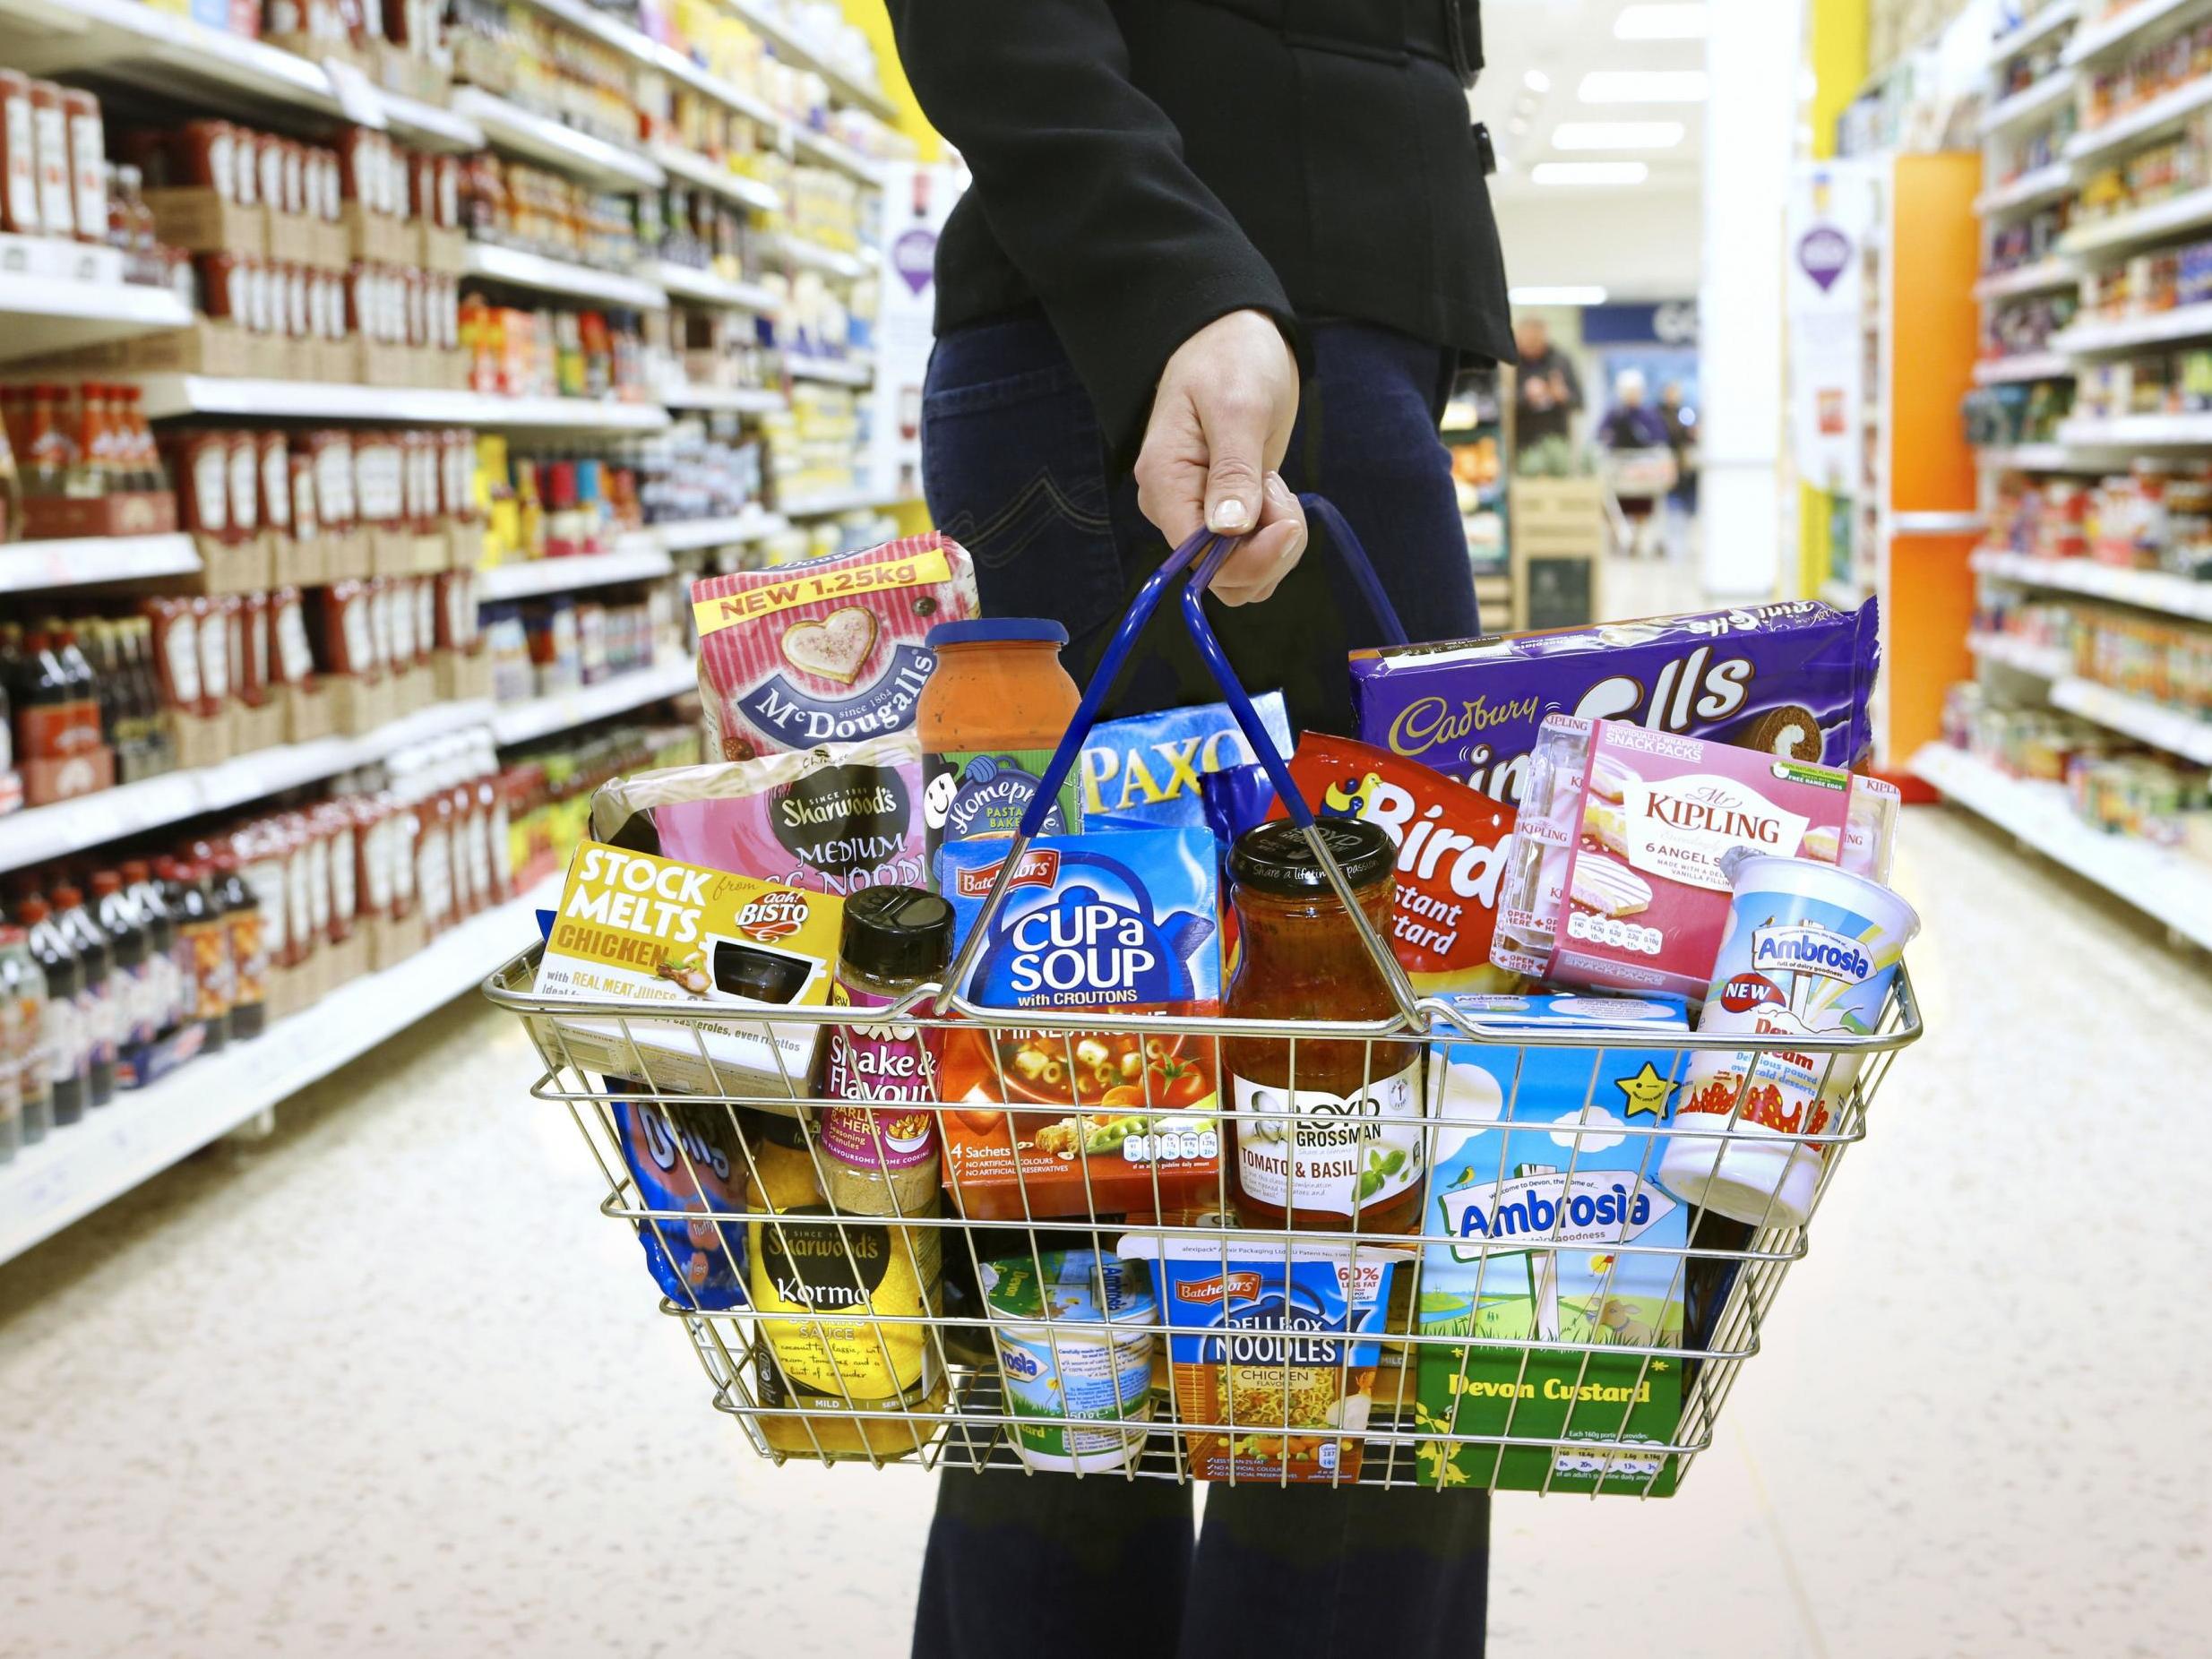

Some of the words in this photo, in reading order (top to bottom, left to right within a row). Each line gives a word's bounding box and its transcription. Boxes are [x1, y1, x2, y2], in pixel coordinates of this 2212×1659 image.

[720, 582, 799, 620] NEW
[811, 564, 917, 596] 1.25kg
[756, 656, 933, 739] McDougalls
[839, 703, 867, 718] since
[870, 689, 891, 708] 1864
[1389, 696, 1539, 757] Cadbury
[1605, 733, 1655, 750] SNACK
[1656, 742, 1702, 761] PACKS
[1805, 778, 1827, 787] RANGE
[782, 786, 897, 828] Sharwood's
[810, 792, 839, 804] SINCE
[1644, 791, 1780, 844] KIPLING
[1521, 822, 1568, 842] KIPLING
[796, 833, 907, 867] MEDIUM
[1646, 843, 1655, 852] 6
[1657, 845, 1709, 865] ANGEL
[580, 848, 714, 907] STOCK
[1253, 864, 1279, 879] Share
[1347, 859, 1379, 879] passion
[1672, 869, 1702, 881] VANILLA
[764, 890, 805, 906] aah!
[1395, 882, 1462, 926] stant
[565, 883, 701, 942] MELTS
[736, 903, 809, 927] BISTO
[1507, 910, 1533, 921] OPEN
[556, 924, 670, 967] CHICKEN
[1759, 935, 1869, 979] Ambrosia
[1011, 948, 1155, 993] SOUP
[1510, 955, 1534, 965] OPEN
[547, 970, 569, 984] with
[572, 971, 600, 987] REAL
[602, 978, 635, 996] MEAT
[1725, 982, 1771, 1001] NEW
[1018, 993, 1050, 1007] with
[1054, 990, 1138, 1004] CROUTONS
[735, 1029, 762, 1042] even
[831, 1035, 915, 1077] Shake
[917, 1052, 936, 1075] &
[830, 1066, 931, 1102] Flavour
[829, 1132, 859, 1150] Granules
[830, 1125, 865, 1146] Seasoning
[1296, 1125, 1381, 1148] GROSSMAN
[829, 1143, 875, 1164] FLAVOURSOME
[951, 1142, 962, 1158] 4
[966, 1147, 1011, 1158] Sachets
[1021, 1165, 1069, 1173] RESERVATIVES
[1242, 1147, 1288, 1176] TOMATO
[1295, 1162, 1305, 1178] &
[1312, 1160, 1357, 1178] BASIL
[1460, 1184, 1650, 1238] Ambrosia
[1338, 1267, 1379, 1280] 60%
[778, 1277, 872, 1305] Korma
[1182, 1280, 1254, 1298] Batcheors
[799, 1328, 855, 1340] SAUCE
[1215, 1337, 1336, 1363] NOODLES
[1241, 1370, 1309, 1381] CHICKEN
[1449, 1374, 1535, 1399] Devon
[1543, 1379, 1650, 1403] Custard
[815, 1399, 839, 1408] MILD
